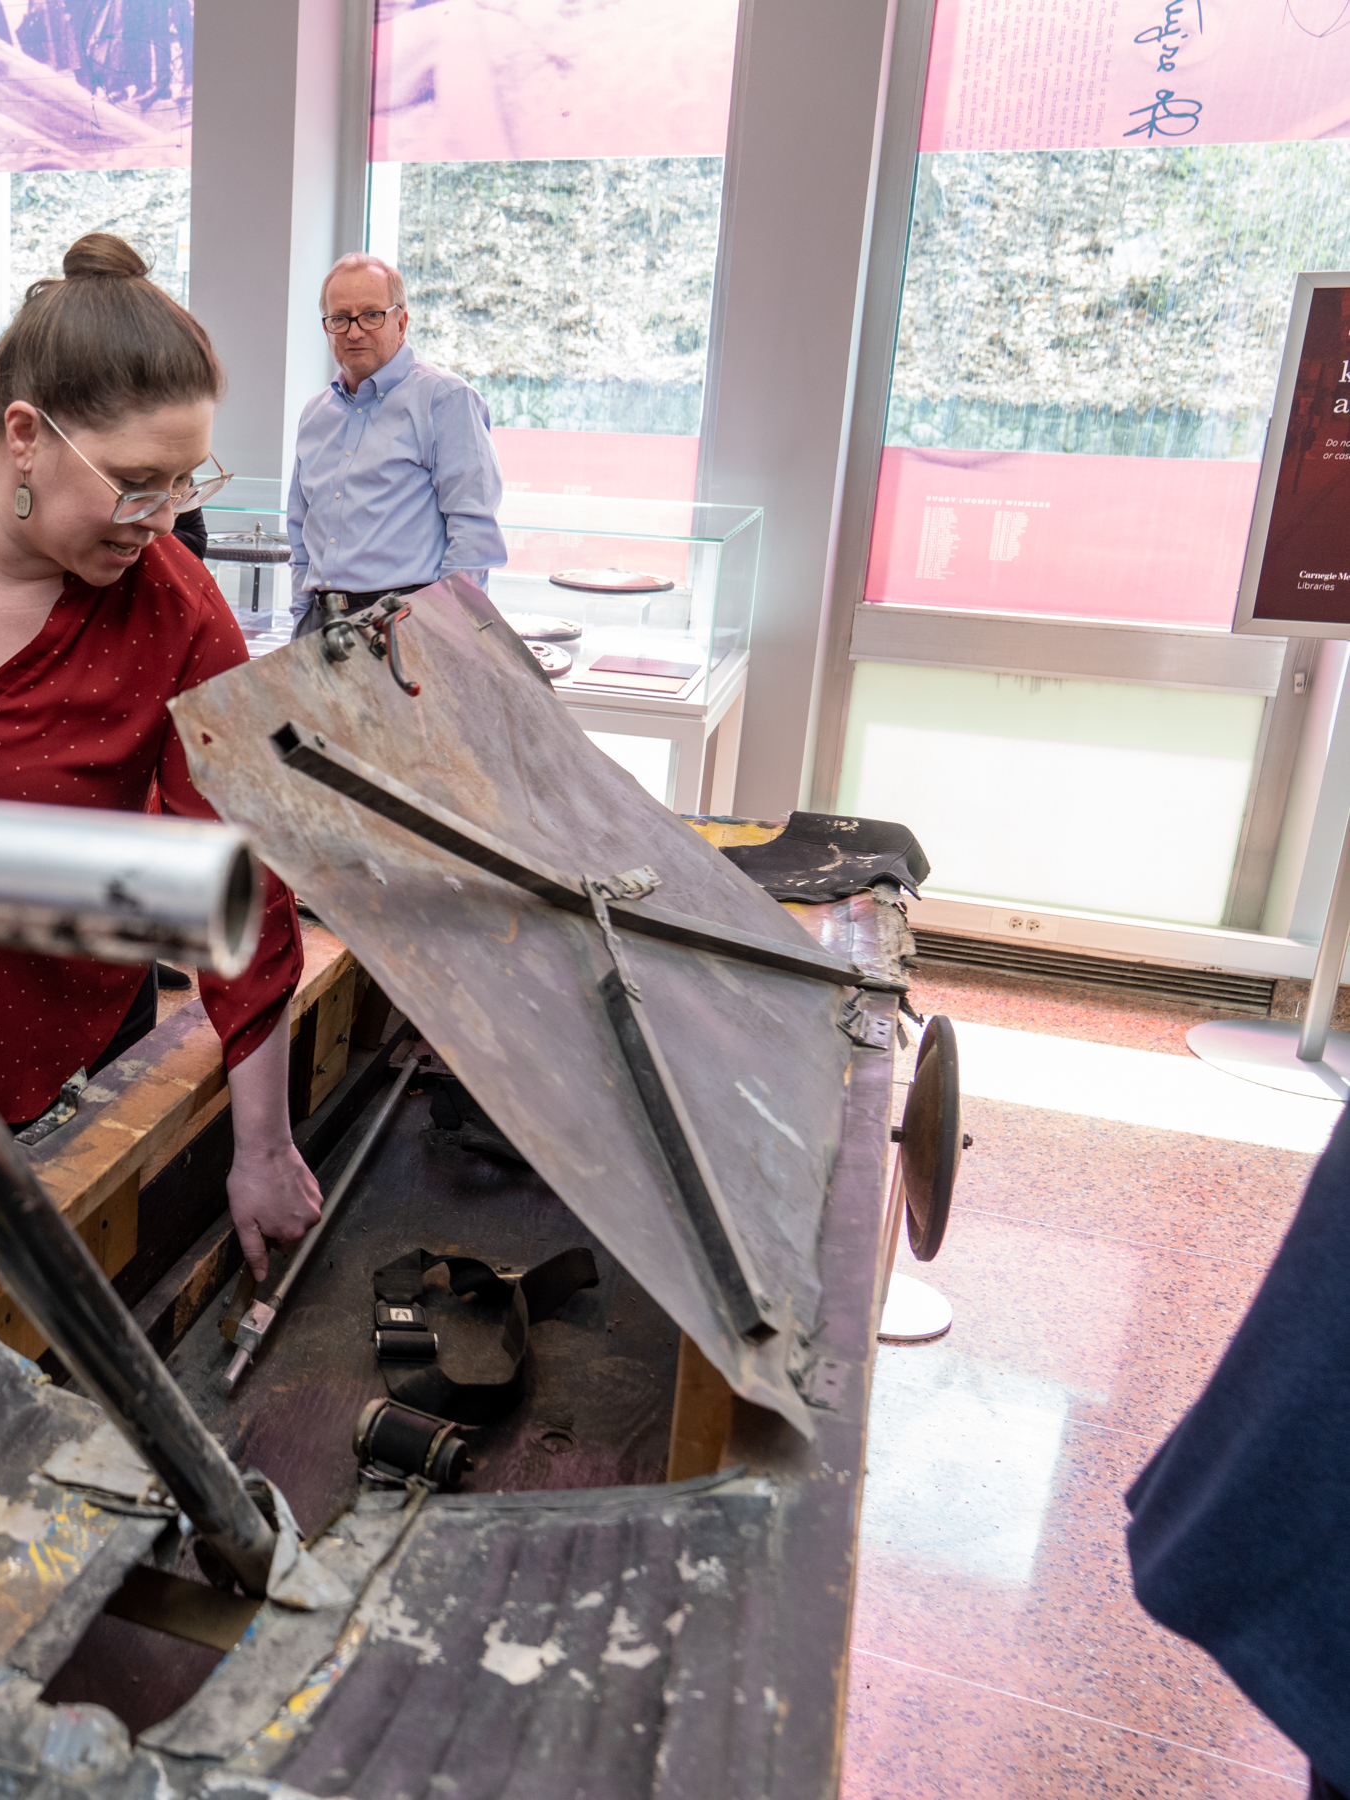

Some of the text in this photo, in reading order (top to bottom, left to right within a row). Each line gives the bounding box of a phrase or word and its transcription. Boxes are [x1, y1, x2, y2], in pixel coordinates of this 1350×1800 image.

[1325, 438, 1339, 448] Do
[1322, 452, 1333, 461] or
[1299, 570, 1337, 582] Carnegie
[1297, 581, 1335, 591] Libraries
